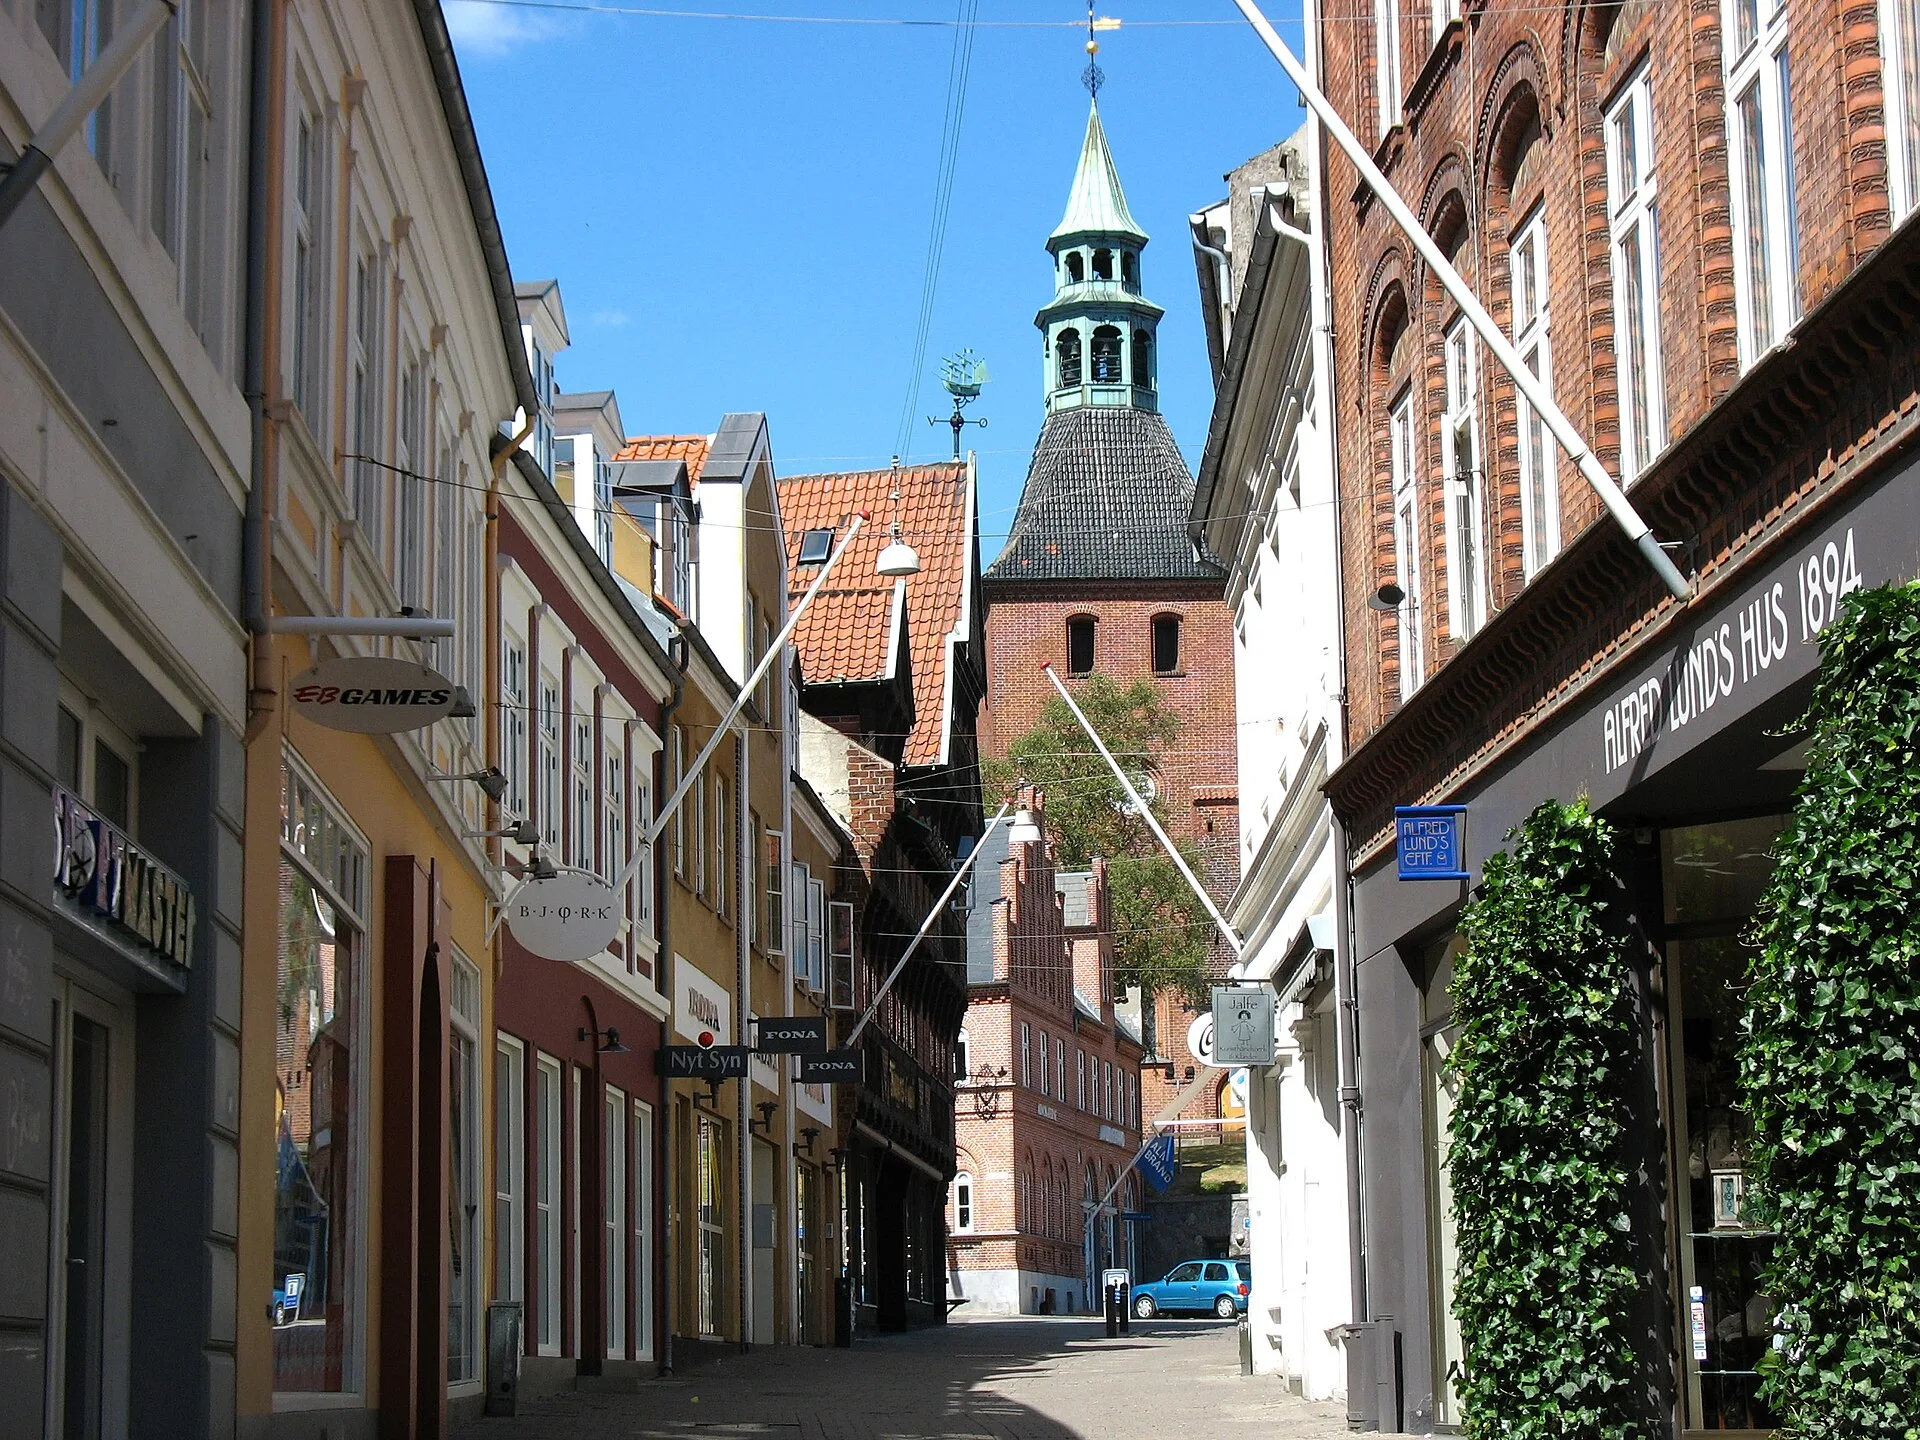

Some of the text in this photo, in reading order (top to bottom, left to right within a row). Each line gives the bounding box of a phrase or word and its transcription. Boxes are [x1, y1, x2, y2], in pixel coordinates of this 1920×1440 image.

[1603, 527, 1863, 775] ALFRED LUND'S HUS 1894
[1403, 821, 1450, 835] ALFRED
[1403, 836, 1449, 850] LUND'S
[765, 1030, 819, 1040] FONA
[671, 1052, 703, 1074] Nyt
[709, 1051, 741, 1074] Syn
[807, 1062, 857, 1071] FONA
[1144, 1149, 1171, 1183] BRAND
